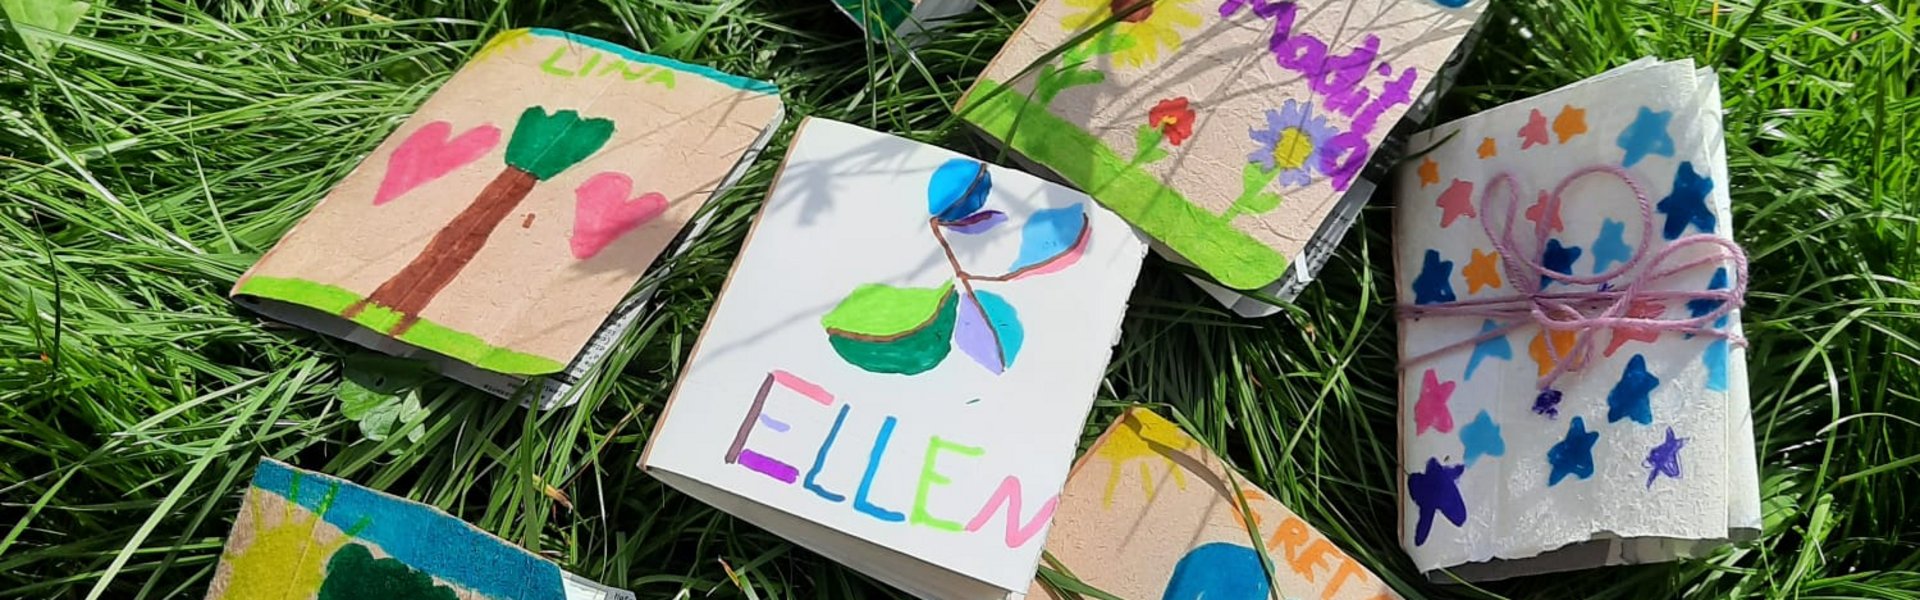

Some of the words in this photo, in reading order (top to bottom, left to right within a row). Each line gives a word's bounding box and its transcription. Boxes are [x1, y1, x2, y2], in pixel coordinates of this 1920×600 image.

[540, 45, 675, 89] LINA
[725, 370, 1060, 548] ELLEN
[1231, 489, 1396, 600] GRET
